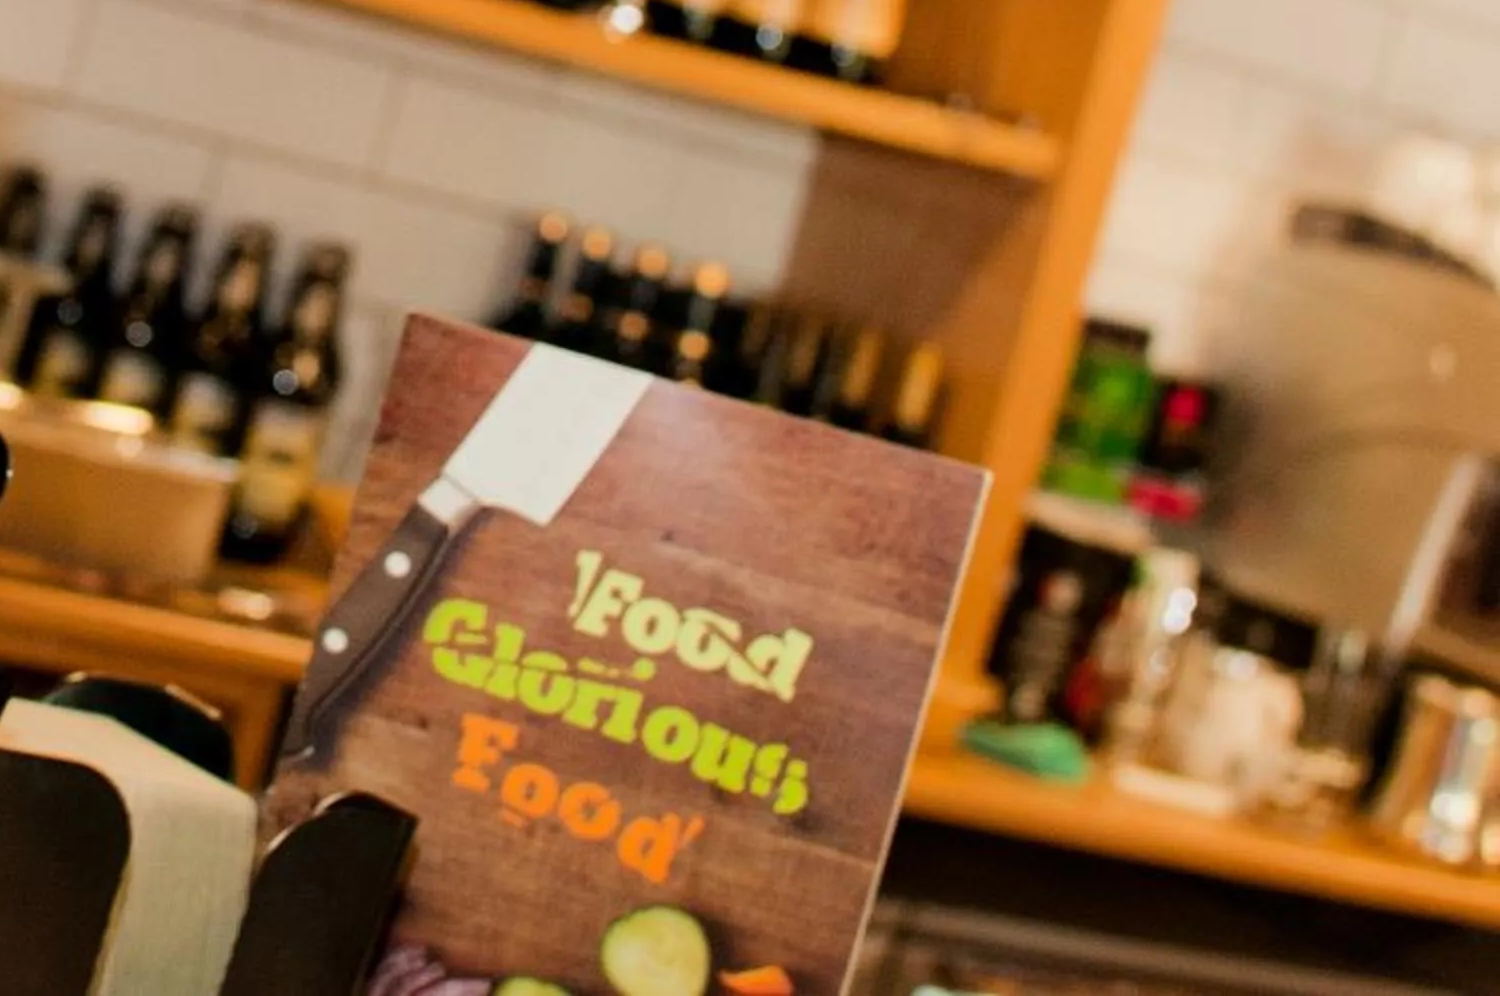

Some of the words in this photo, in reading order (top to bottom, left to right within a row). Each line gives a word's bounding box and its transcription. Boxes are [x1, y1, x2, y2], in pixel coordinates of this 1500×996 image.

[424, 600, 808, 814] Glorious
[569, 551, 813, 701] Food
[453, 714, 702, 883] Food
